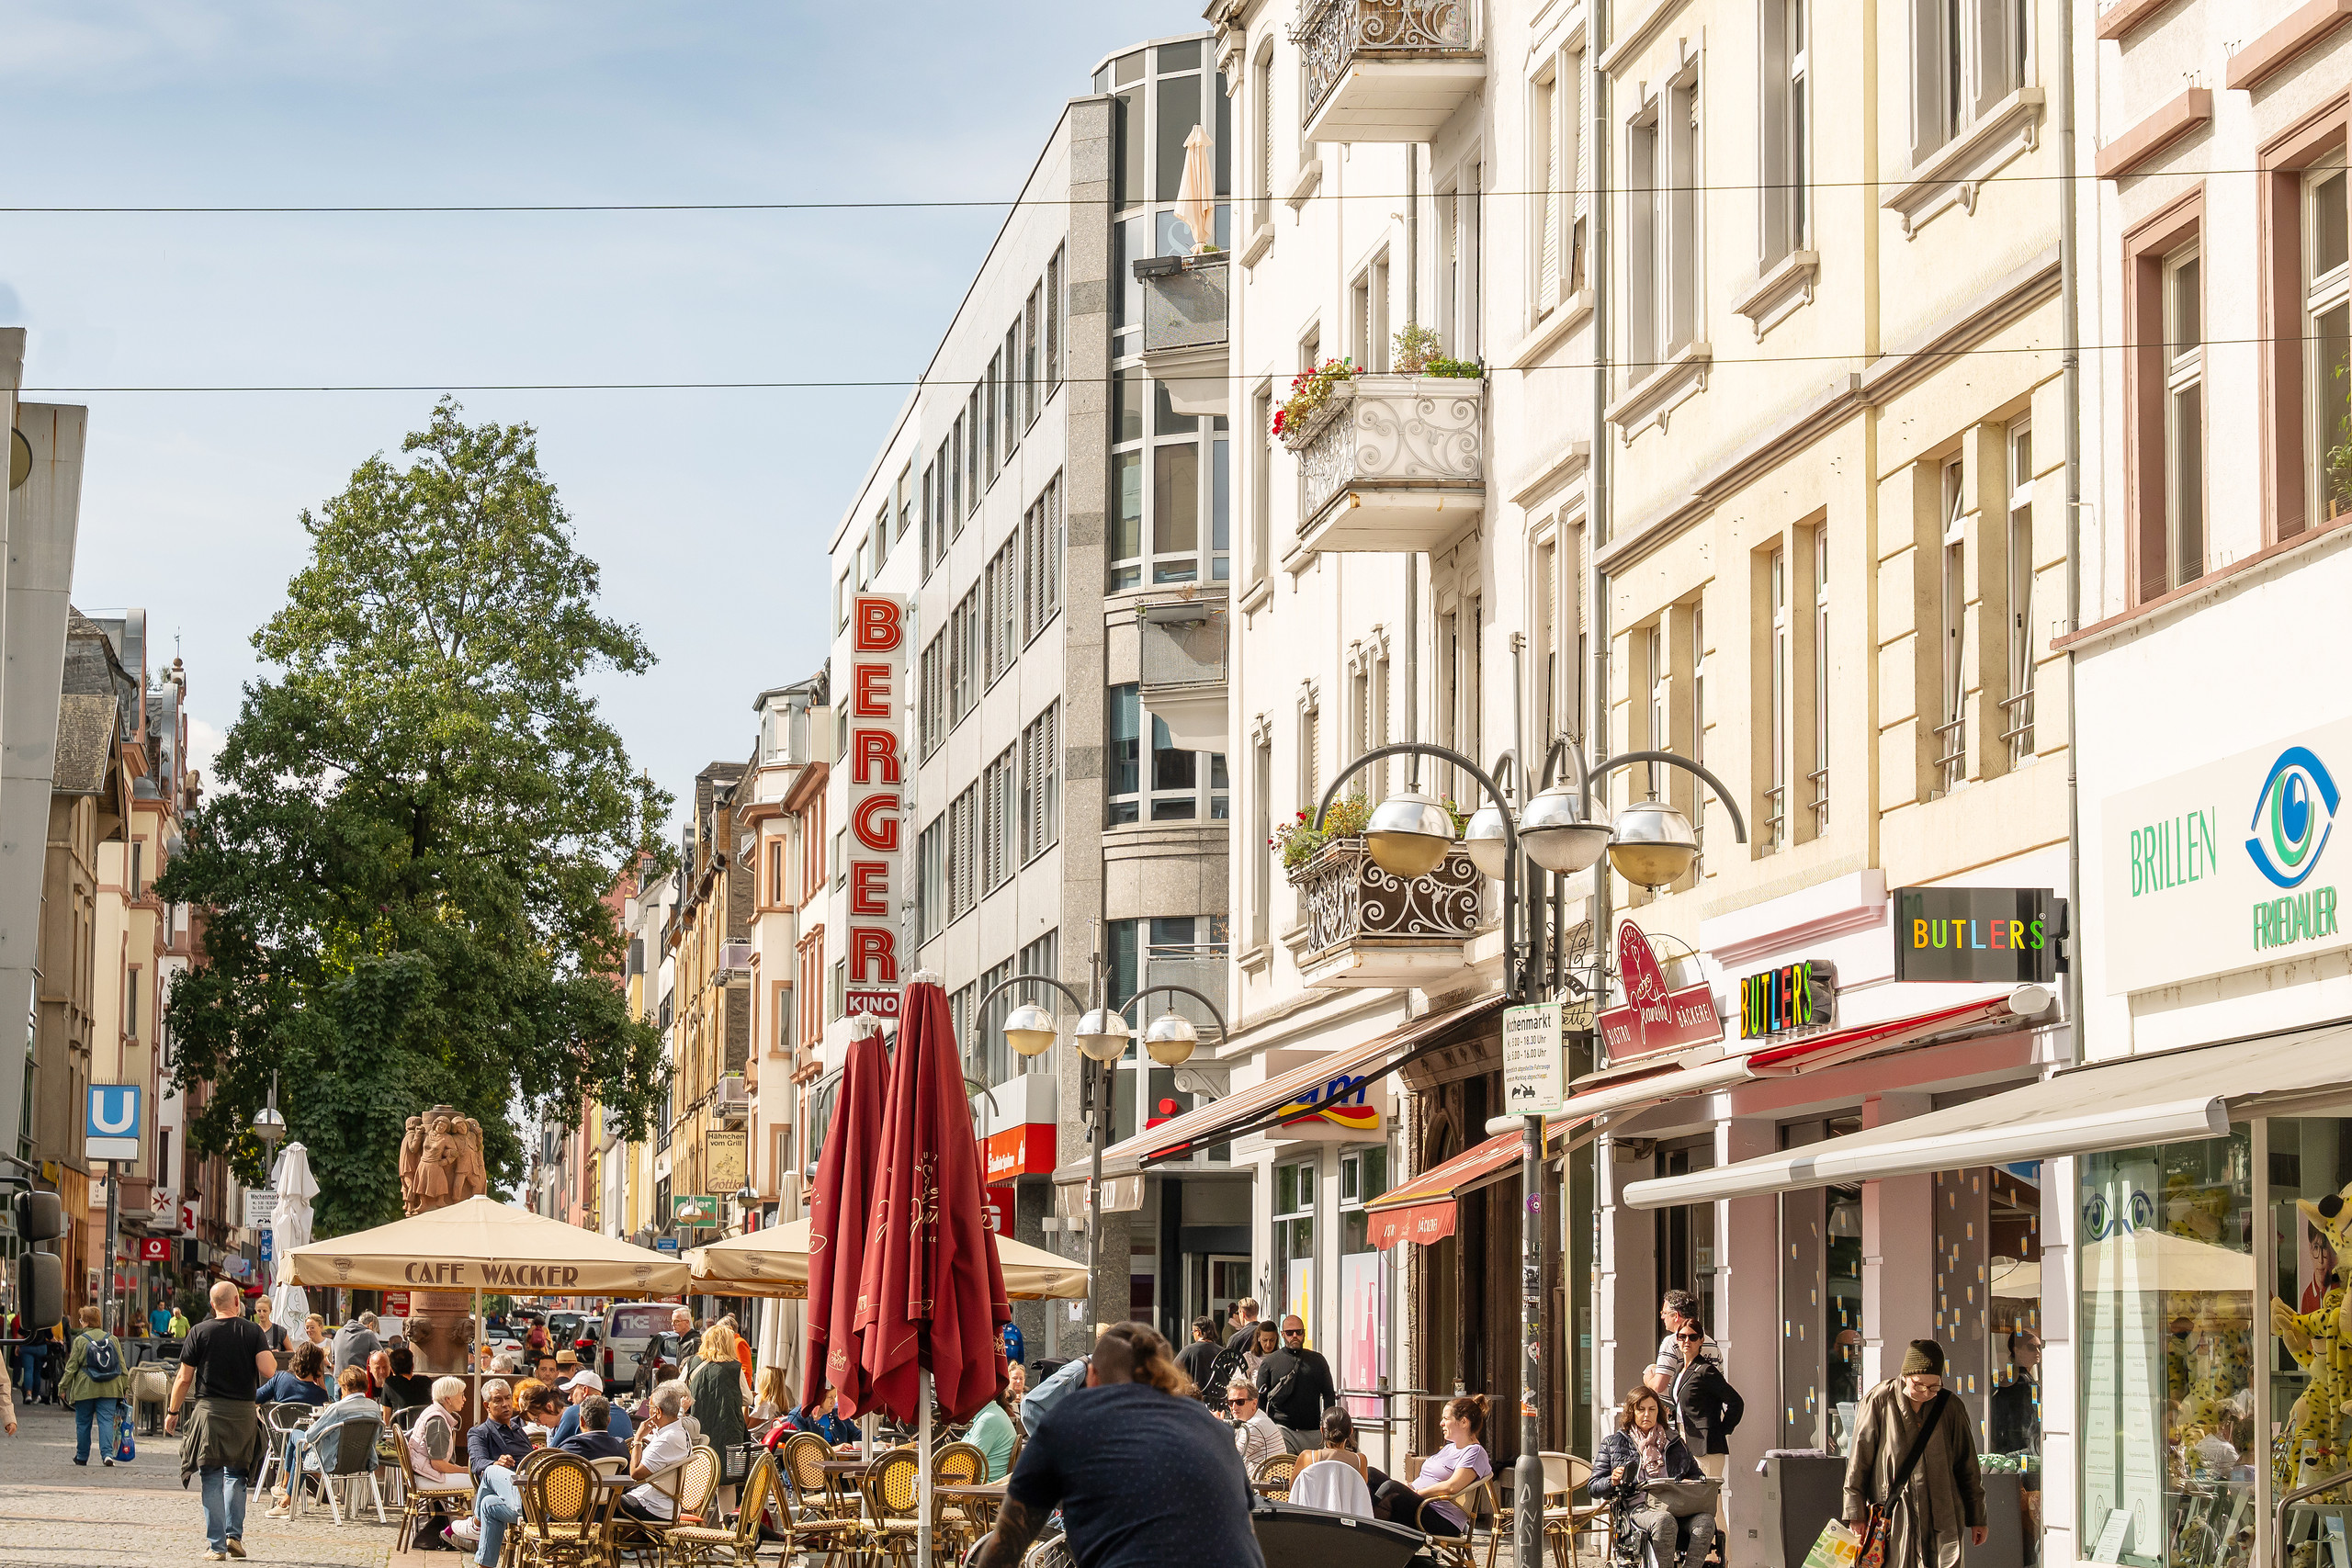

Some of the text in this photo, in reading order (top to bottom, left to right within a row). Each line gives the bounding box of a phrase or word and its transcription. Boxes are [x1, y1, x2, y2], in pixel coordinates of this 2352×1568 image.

[850, 596, 903, 984] BERGER
[2131, 806, 2216, 897] BRILLEN
[2253, 886, 2338, 952] FRIEDAUER
[1913, 919, 2045, 950] BUTLERS
[848, 996, 898, 1012] KINO
[1740, 961, 1813, 1040] BUTLERS
[1676, 1002, 1713, 1029] BÄCKEREI
[1606, 1024, 1632, 1046] BISTRO
[92, 1089, 135, 1134] U
[707, 1177, 745, 1191] Göttke
[404, 1261, 579, 1288] CAFE WACKER
[618, 1314, 650, 1329] TKE
